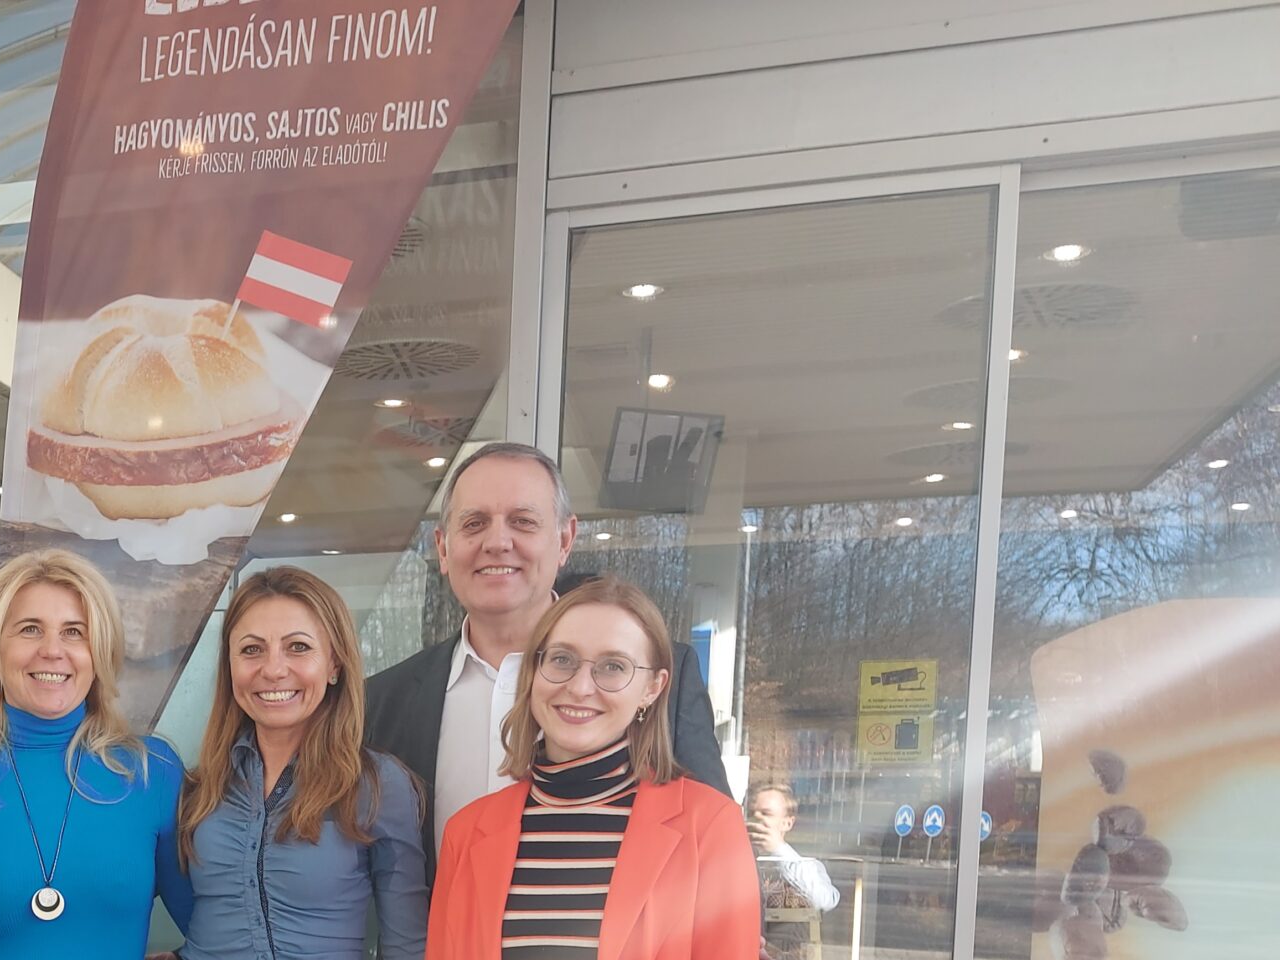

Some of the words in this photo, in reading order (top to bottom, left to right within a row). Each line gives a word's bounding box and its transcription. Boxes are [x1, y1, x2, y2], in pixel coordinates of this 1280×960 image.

[140, 13, 317, 83] LEGENDÁSAN
[327, 6, 437, 63] FINOM!
[114, 111, 261, 154] HAGYOMÁNYOS,
[266, 106, 341, 140] SAJTOS
[345, 111, 377, 134] VAGY
[381, 99, 450, 132] CHILIS
[158, 154, 192, 179] KÉRJE
[194, 150, 246, 175] FRISSEN,
[250, 144, 299, 171] FORRÓN
[302, 146, 318, 167] AZ
[322, 141, 389, 166] ELADÓTÓL!
